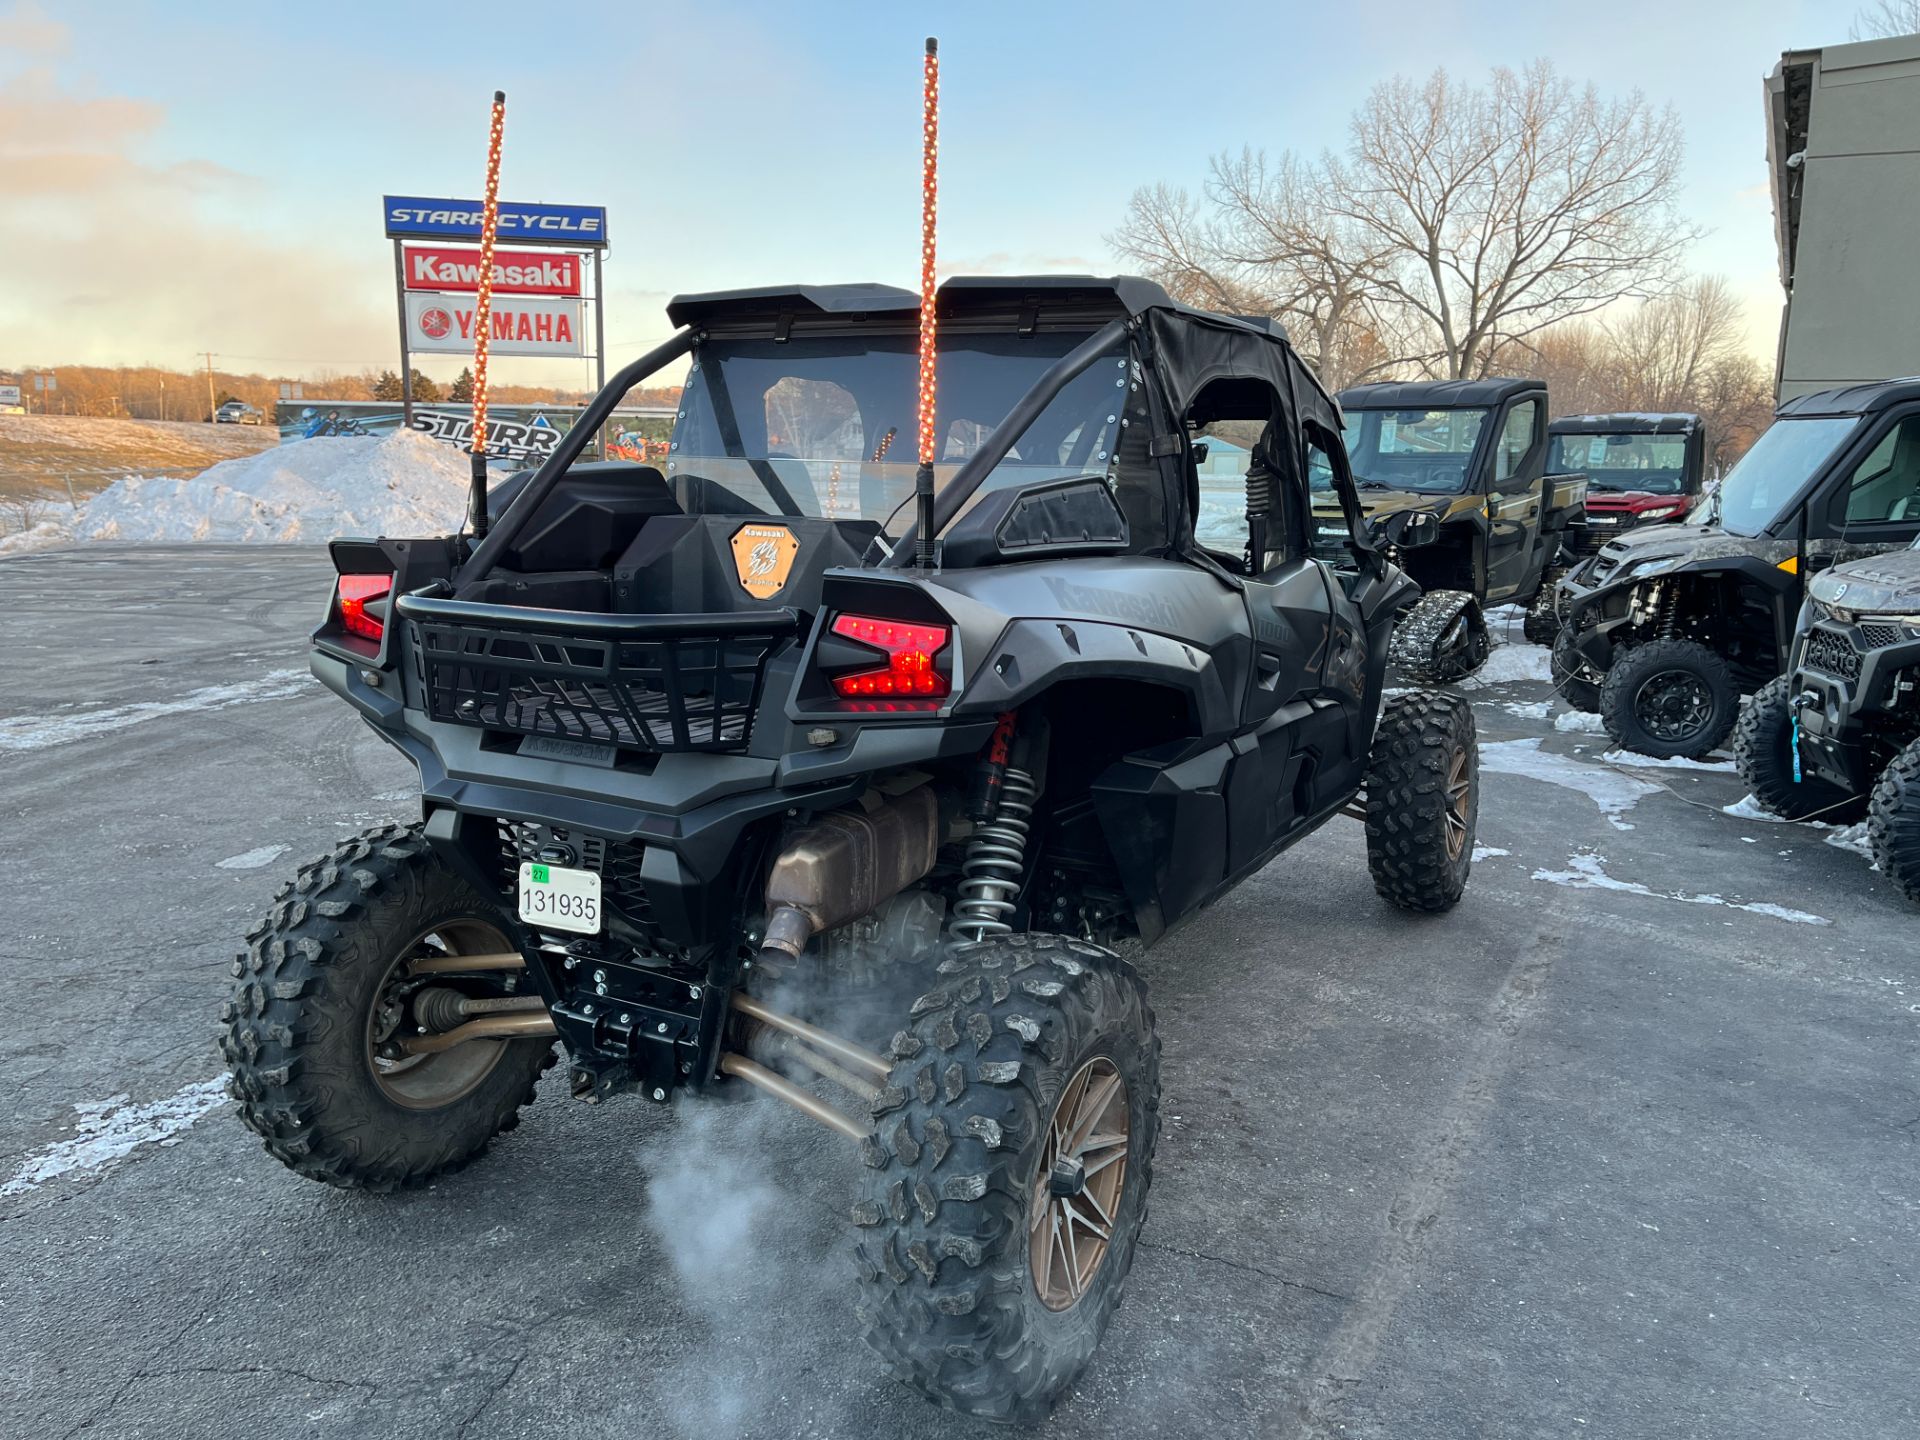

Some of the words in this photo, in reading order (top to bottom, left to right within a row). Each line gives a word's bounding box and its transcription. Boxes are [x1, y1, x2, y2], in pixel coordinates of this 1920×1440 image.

[390, 209, 485, 225] STARR
[496, 214, 600, 232] CYCLE
[414, 255, 572, 288] Kawasaki
[454, 310, 573, 343] YMAHA
[745, 529, 785, 538] Kawasaki
[1040, 576, 1178, 628] Kawasaki
[532, 869, 543, 880] 27
[523, 888, 596, 920] 131935
